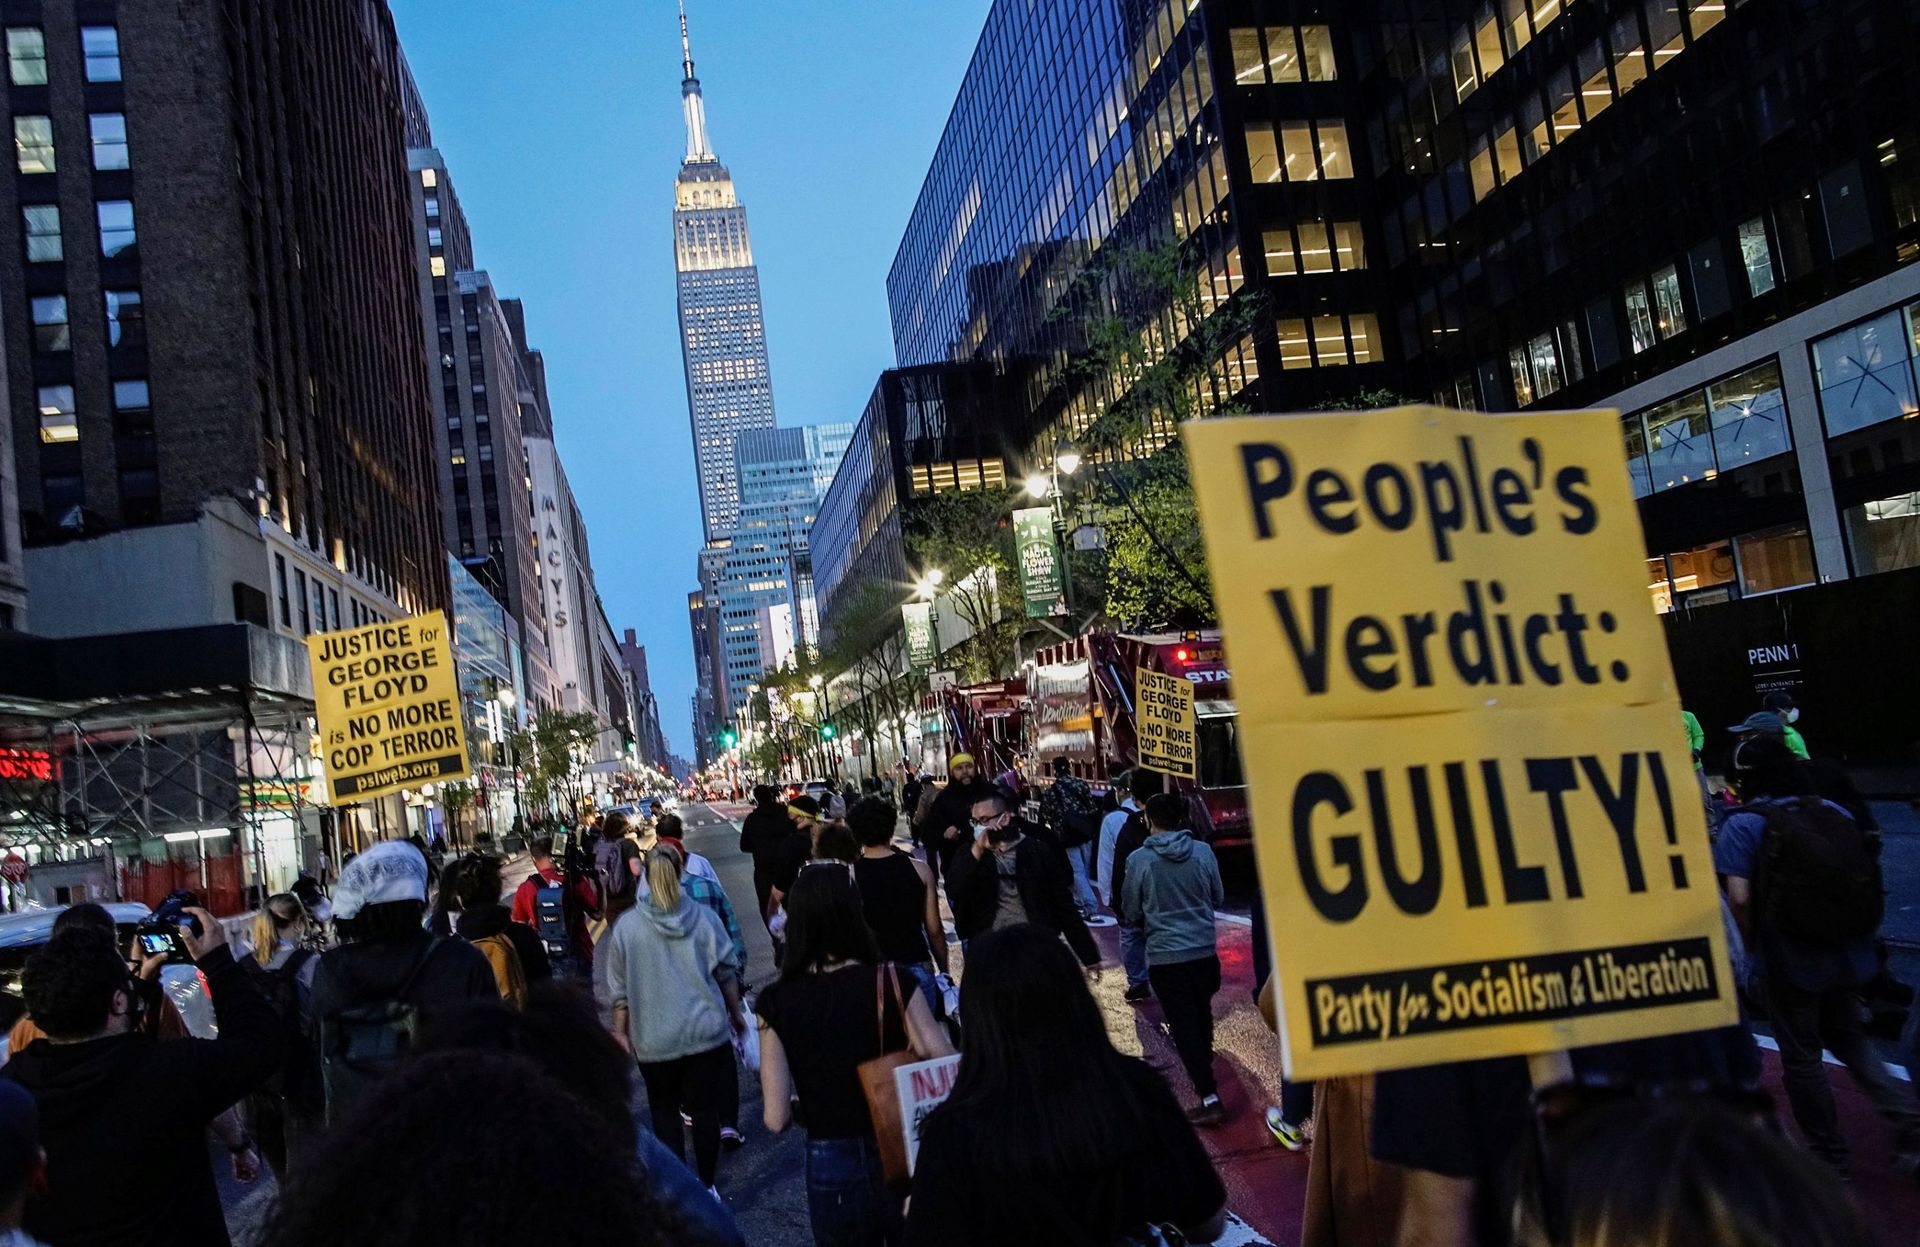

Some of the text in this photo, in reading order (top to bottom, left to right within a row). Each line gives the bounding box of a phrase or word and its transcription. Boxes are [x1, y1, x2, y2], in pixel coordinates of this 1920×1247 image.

[1238, 436, 1598, 562] People's
[541, 495, 568, 627] MACY'S
[1022, 556, 1054, 568] FLOWER
[319, 625, 440, 663] JUSTICE for
[1267, 580, 1630, 696] Verdict:
[1748, 643, 1799, 665] PENN 1
[328, 647, 438, 686] GEORGE
[1139, 671, 1191, 696] JUSTICE for
[343, 674, 428, 709] FLOYD
[1141, 689, 1188, 711] GEORGE
[330, 699, 453, 745] is NO MORE
[1146, 704, 1182, 724] FLOYD
[331, 726, 459, 771] COP TERROR
[1140, 722, 1191, 744] is NO MORE
[1140, 736, 1192, 760] COP TERROR
[356, 761, 440, 792] pslweb.org
[1290, 751, 1688, 923] GUILTY!
[1315, 947, 1710, 1041] Party for Socialism & Liberation
